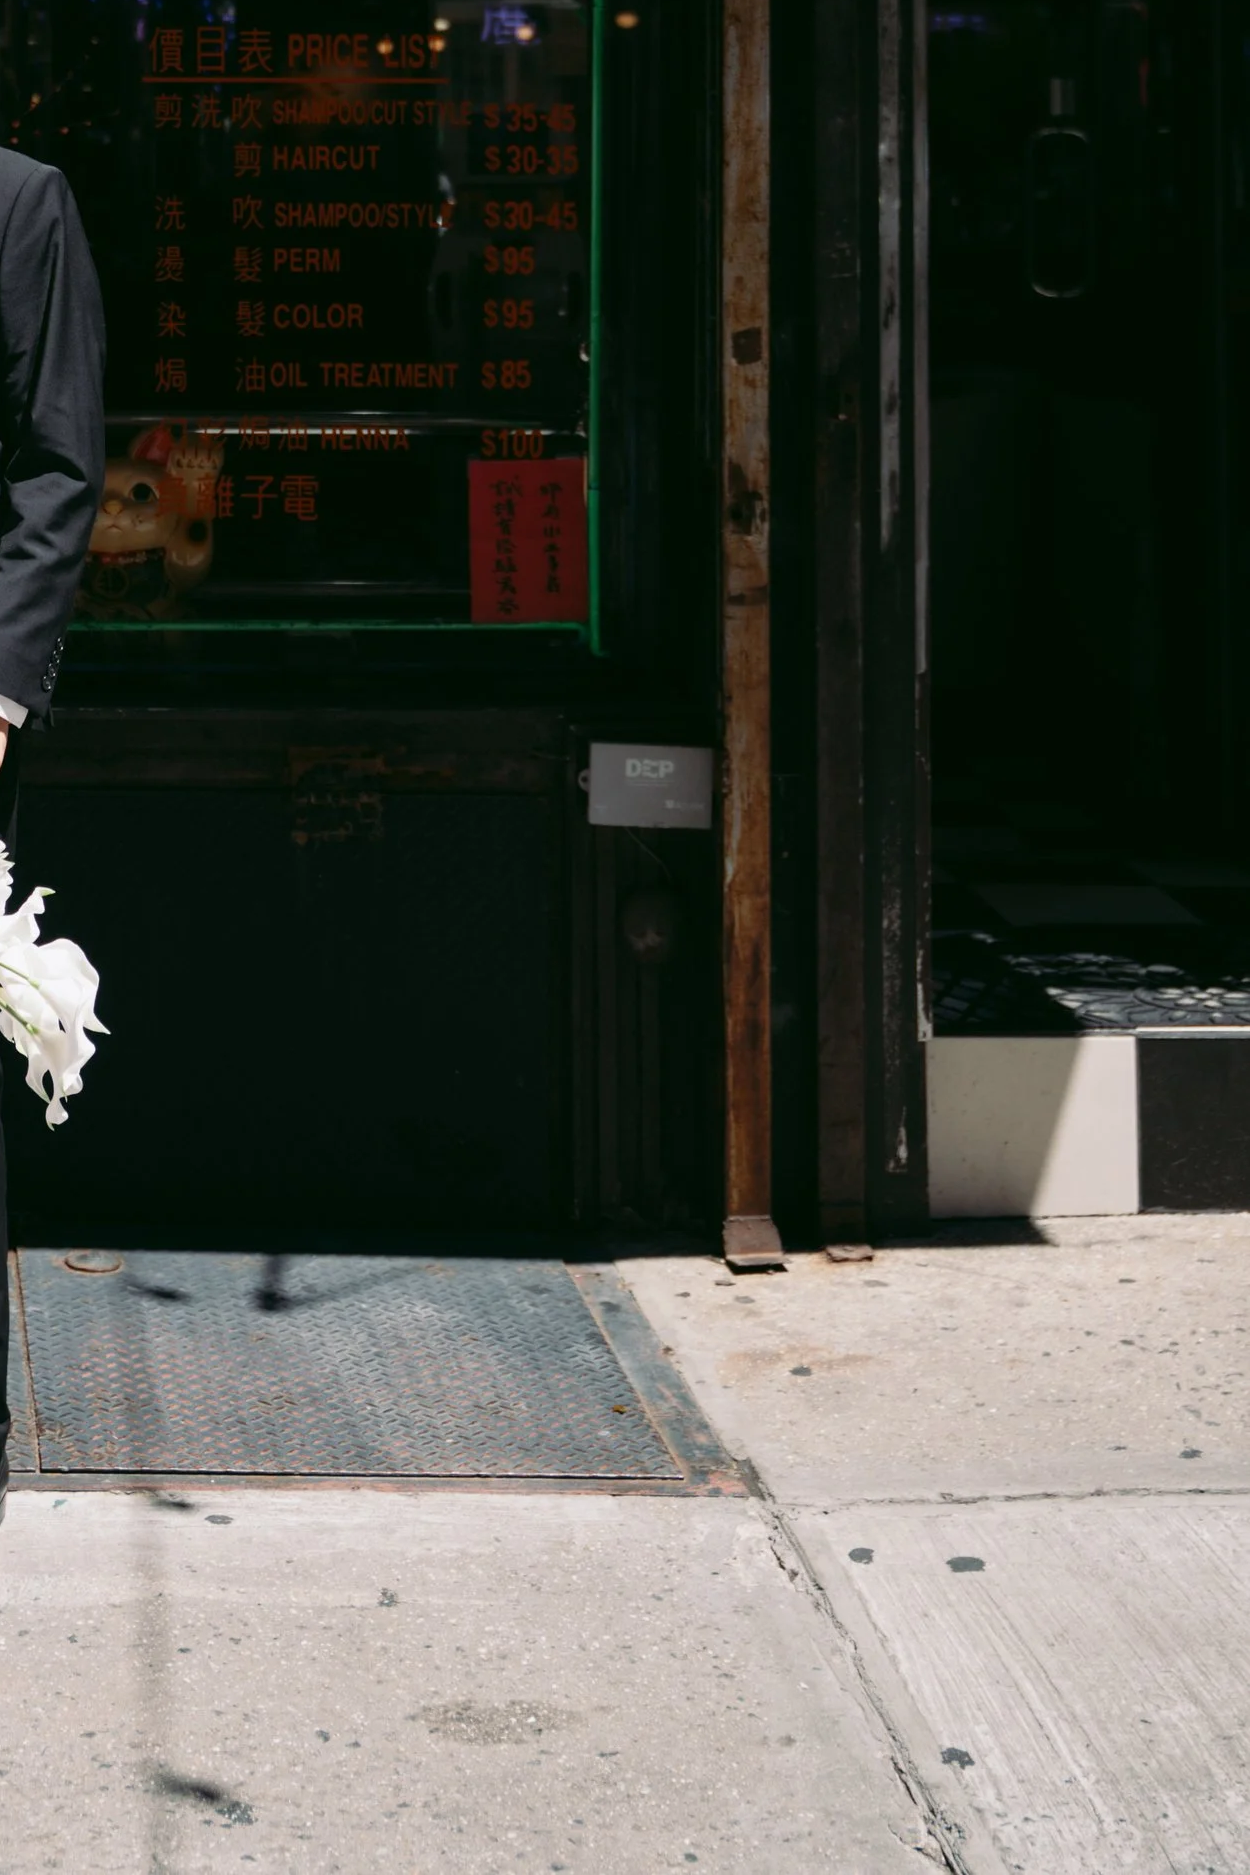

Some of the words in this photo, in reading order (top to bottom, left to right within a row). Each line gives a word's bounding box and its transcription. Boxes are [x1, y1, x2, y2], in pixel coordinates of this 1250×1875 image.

[150, 25, 273, 76] 價目表
[287, 34, 369, 70] PRICE
[382, 32, 442, 69] LIST
[154, 92, 264, 130] 剪洗吹
[271, 98, 408, 126] SHAMPOO/CUT
[413, 98, 472, 127] STYLE
[233, 143, 263, 180] 剪
[272, 145, 380, 171] HAIRCUT
[274, 202, 455, 228] SHAMPOO/STYLE
[273, 247, 341, 274] PERM
[484, 245, 535, 274] $95
[273, 303, 364, 329] COLOR
[483, 299, 535, 328] $95
[270, 362, 308, 388] OIL
[321, 362, 458, 388] TREATMENT
[481, 360, 532, 389] $85
[321, 423, 410, 451] HENNA
[481, 429, 544, 459] $100
